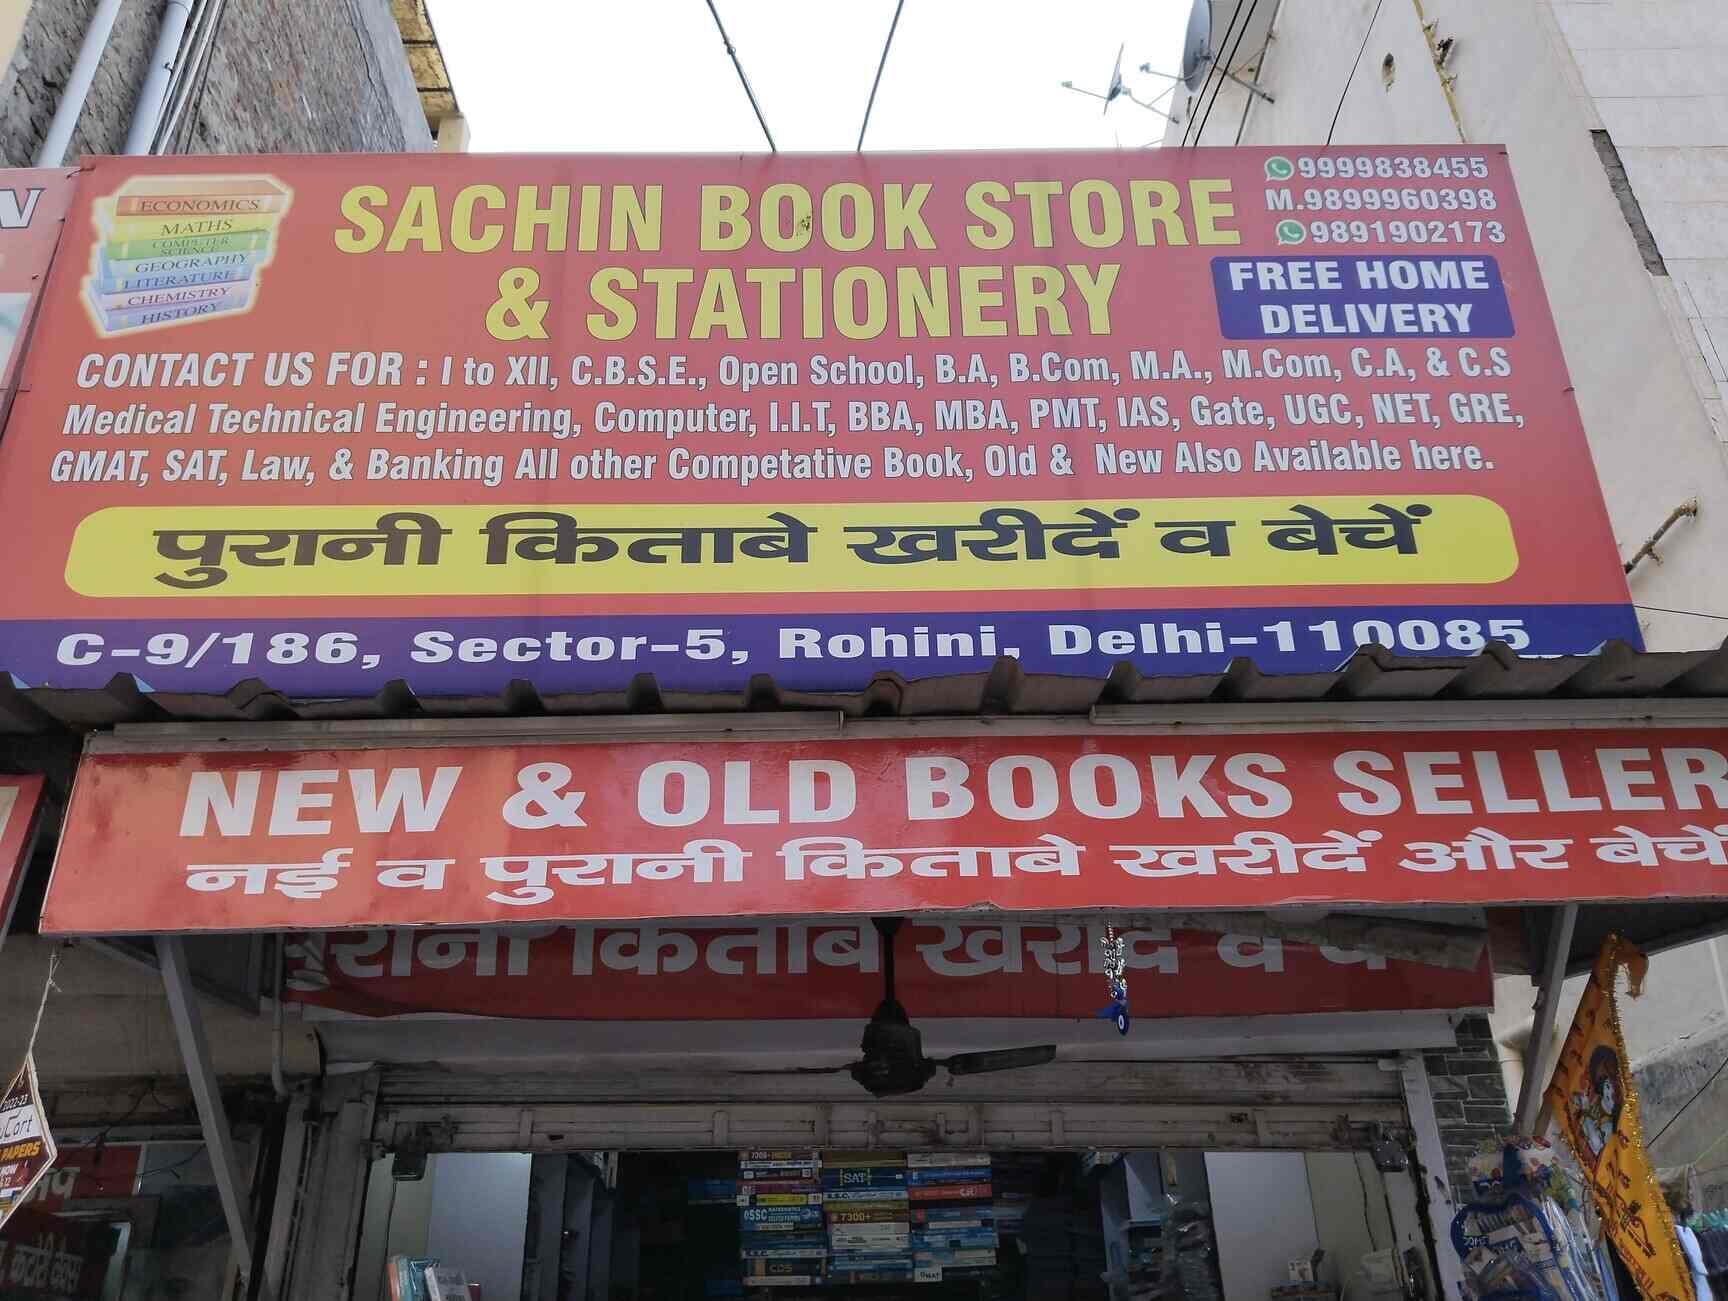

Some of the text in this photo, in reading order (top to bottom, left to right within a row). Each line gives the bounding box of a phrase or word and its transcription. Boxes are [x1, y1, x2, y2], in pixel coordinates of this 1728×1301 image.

[1298, 156, 1489, 180] 9999838455
[139, 198, 260, 212] ECONOMICS
[1264, 188, 1497, 212] M.9899960398
[160, 219, 233, 236] MATHS
[334, 178, 1242, 254] SACHIN BOOK STORE
[1310, 220, 1506, 244] 9891902173
[135, 253, 249, 274] GEOGRAPHY
[1229, 260, 1489, 291] FREE HOME
[122, 270, 233, 289] LITERATURE
[128, 286, 231, 306] CHEMISTRY
[484, 264, 1121, 341] & STATIONERY
[141, 302, 222, 325] HISTORY
[1260, 303, 1472, 334] DELIVERY
[76, 351, 254, 389] CONTACT
[263, 351, 313, 387] US
[326, 351, 403, 387] FOR
[441, 358, 452, 386] I
[463, 358, 495, 387] to
[504, 356, 559, 391] XII,
[570, 354, 707, 390] C.B.S.E.,
[718, 354, 798, 392] Open
[809, 353, 924, 390] School,
[935, 353, 999, 389] B.A,
[1009, 351, 1120, 386] B.Com,
[1130, 349, 1213, 384] M.A.,
[1222, 348, 1342, 383] M.Com,
[1351, 347, 1416, 382] C.A,
[1424, 347, 1451, 376] &
[1458, 347, 1511, 376] C.S
[62, 394, 1525, 440] Medical Technical Engineering, Computer, I.I.T, BBA, MBA, PMT, IAS, Gate, UGC, NET, GRE,
[50, 439, 1496, 486] GMAT, SAT, Law, & Banking All other Competative Book, Old & New Also Available here.
[152, 503, 1433, 589] पुरानी किताबे खरीदें व बेचें
[56, 619, 1530, 669] C-9/186, Sector-5, Rohini, Delhi-110085
[178, 747, 1728, 837] NEW & OLD BOOKS SELLER
[186, 848, 353, 899] नई
[376, 859, 456, 890] व
[479, 839, 752, 906] पुरानी
[776, 836, 1086, 880] किताबे
[1109, 830, 1383, 877] खरीदें
[1398, 826, 1574, 872] और
